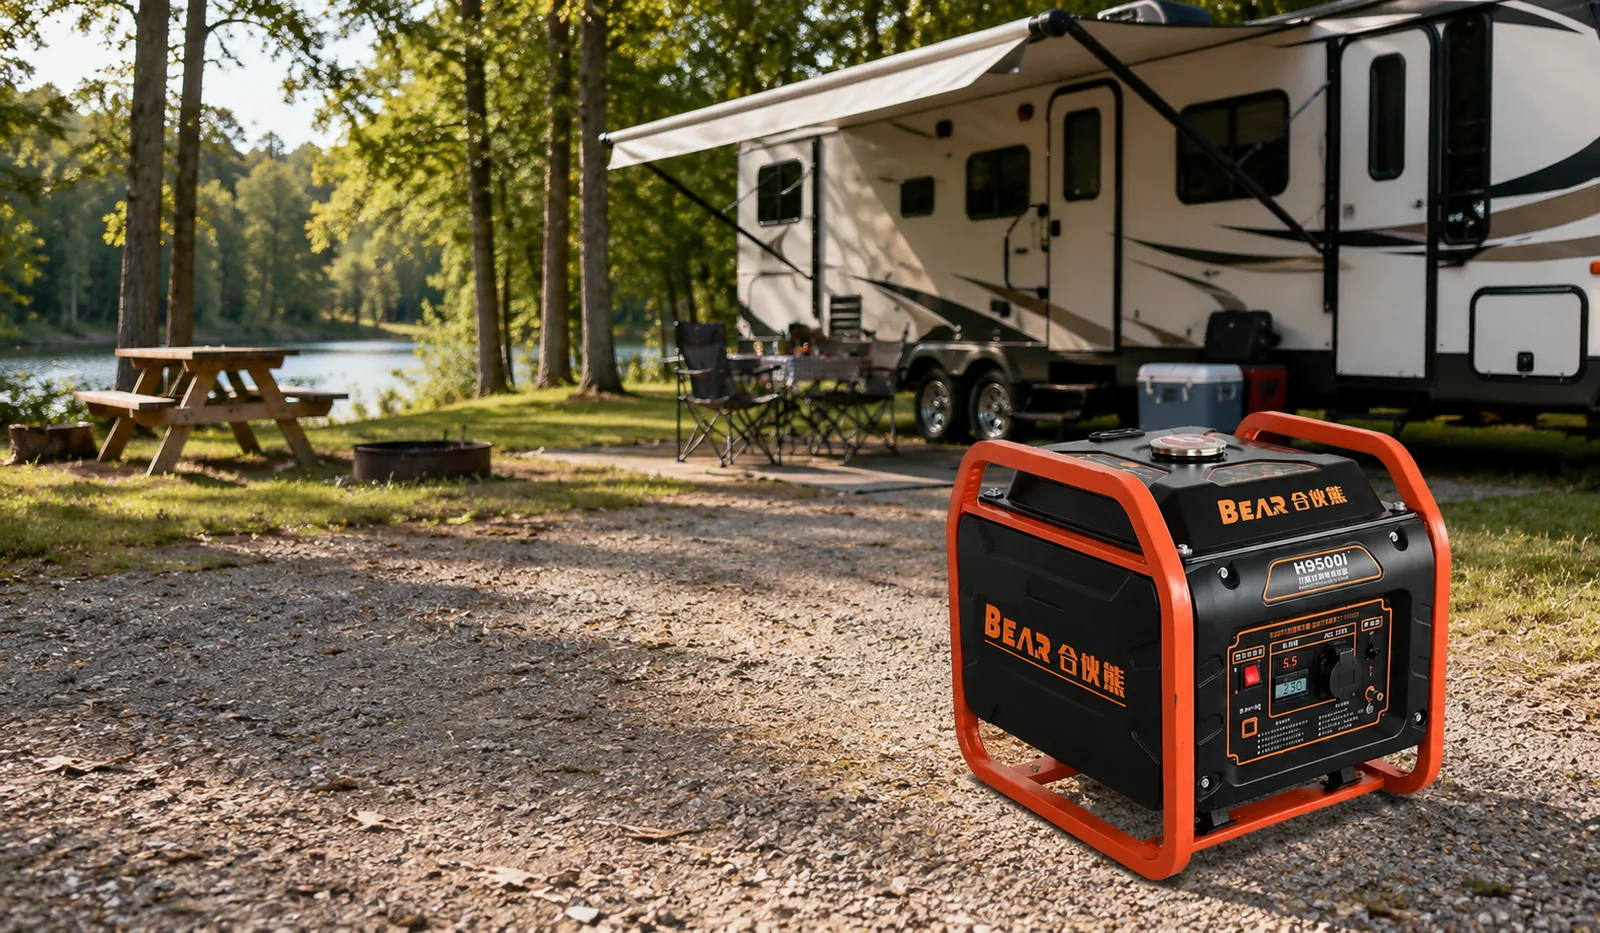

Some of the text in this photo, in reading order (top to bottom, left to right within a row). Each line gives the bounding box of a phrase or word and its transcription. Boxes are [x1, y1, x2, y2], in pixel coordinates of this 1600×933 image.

[1217, 485, 1348, 525] BEAR 合伙熊
[984, 603, 1126, 699] BEAR 合伙熊
